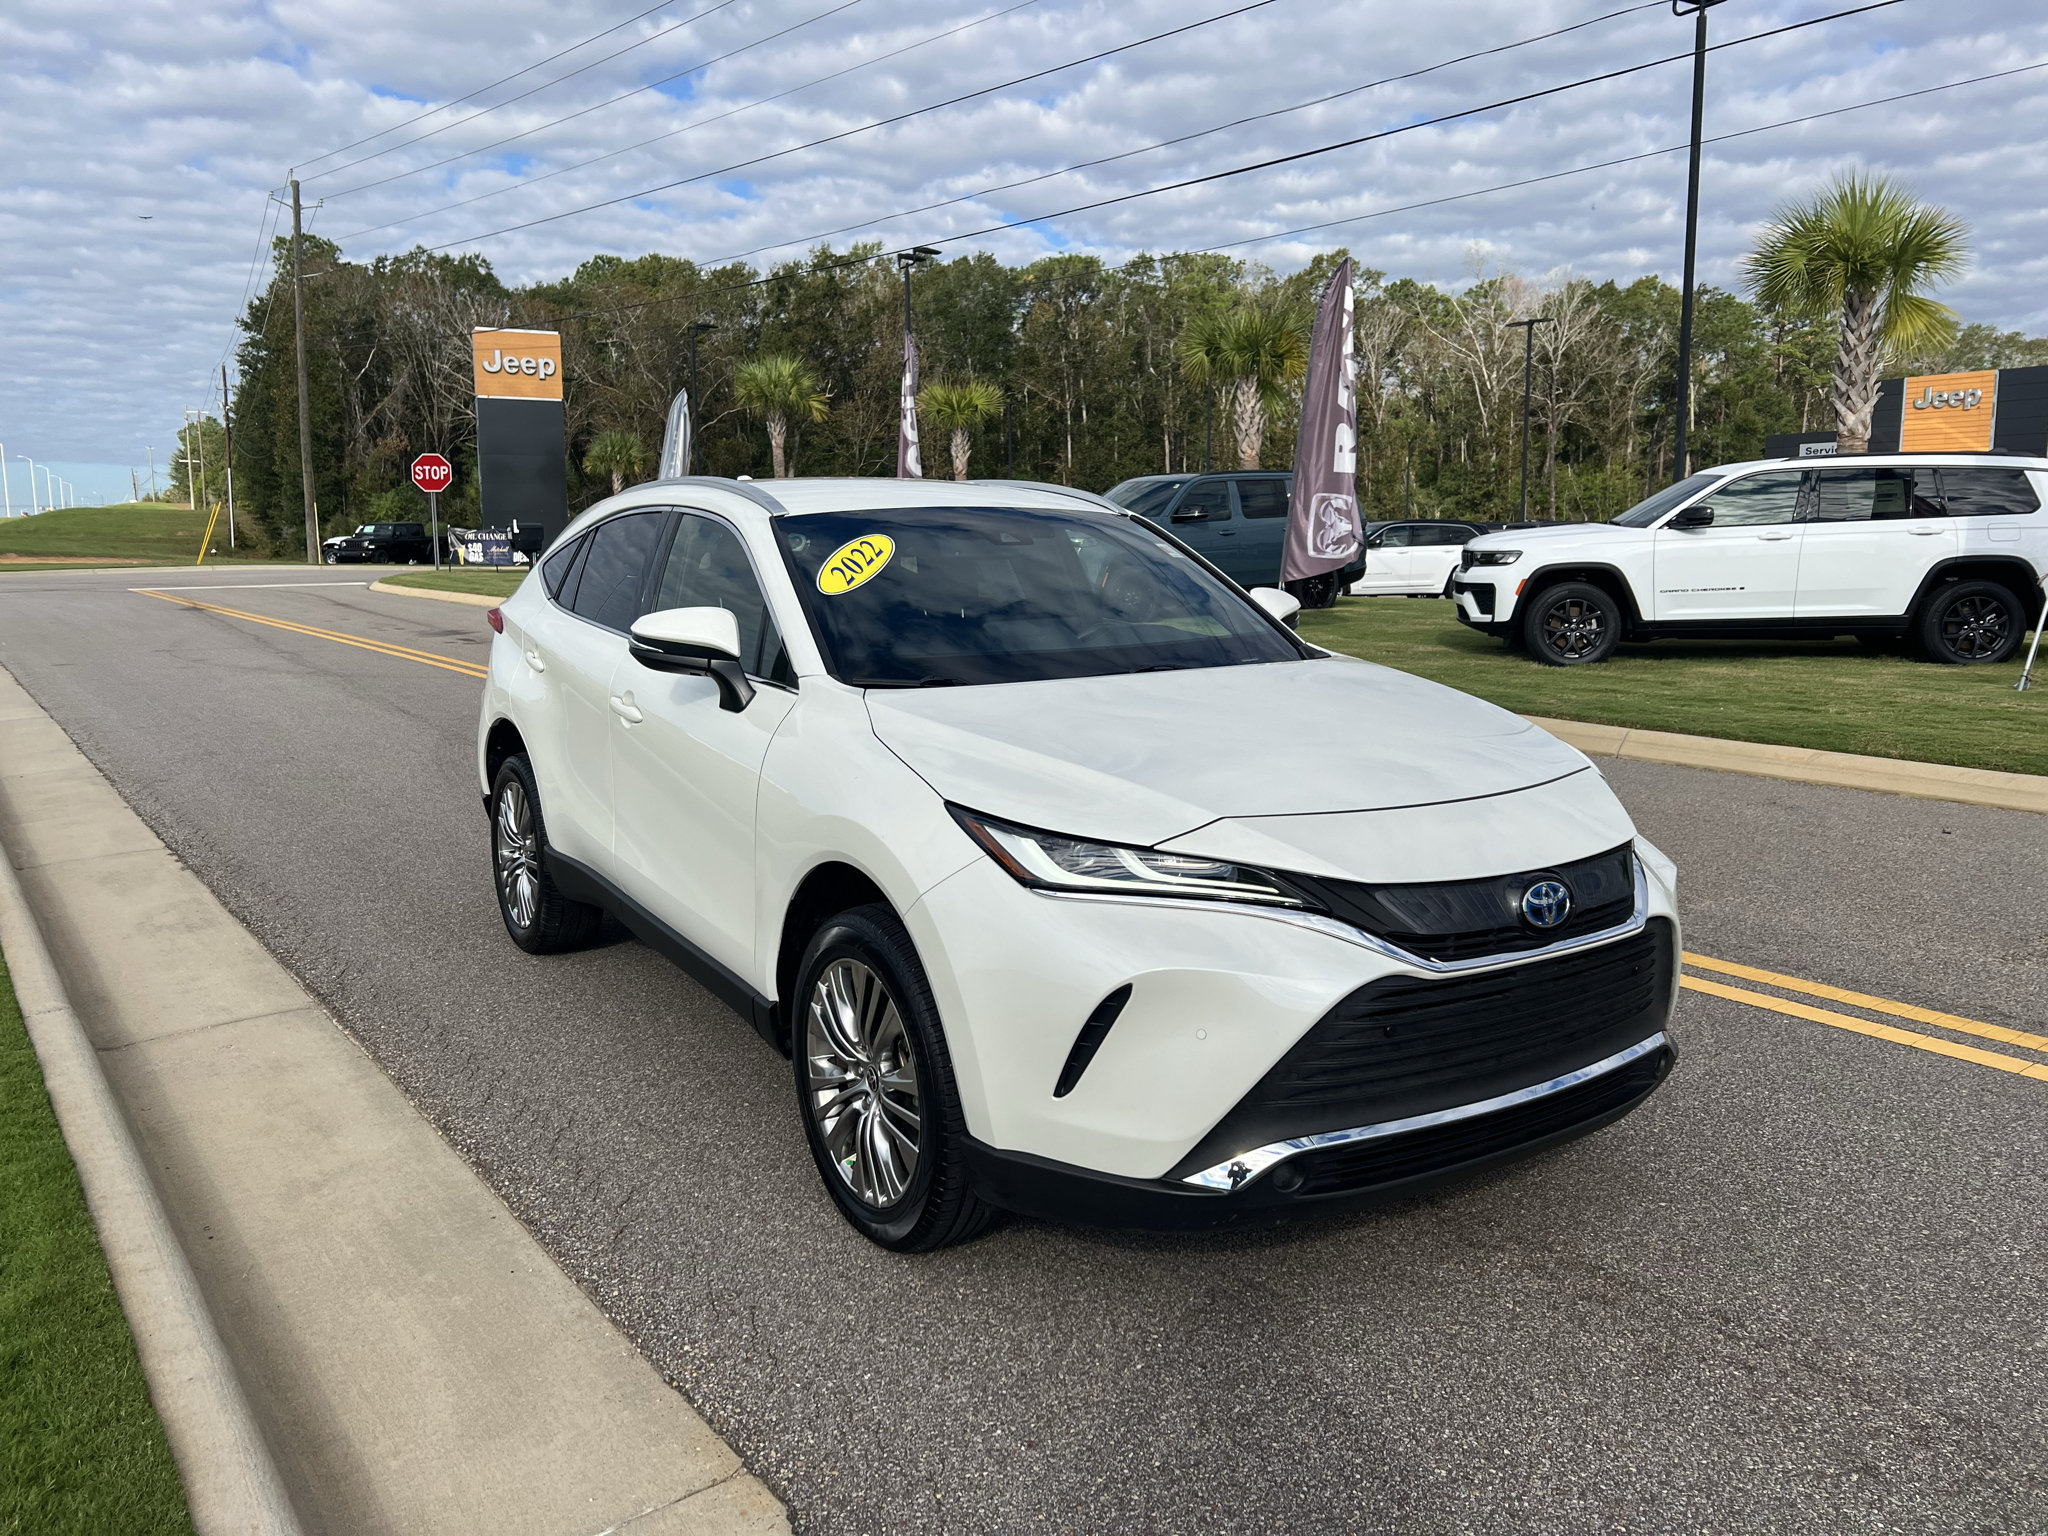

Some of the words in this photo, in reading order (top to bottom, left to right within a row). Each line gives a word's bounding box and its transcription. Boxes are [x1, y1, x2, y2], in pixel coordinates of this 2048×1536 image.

[482, 349, 555, 380] Jeep
[1913, 386, 1982, 410] Jeep
[1805, 446, 1837, 455] Servi
[415, 465, 448, 480] STOP
[464, 532, 477, 540] OIL
[477, 532, 508, 540] CHANGE
[468, 552, 484, 562] GAS
[830, 540, 884, 587] 2022
